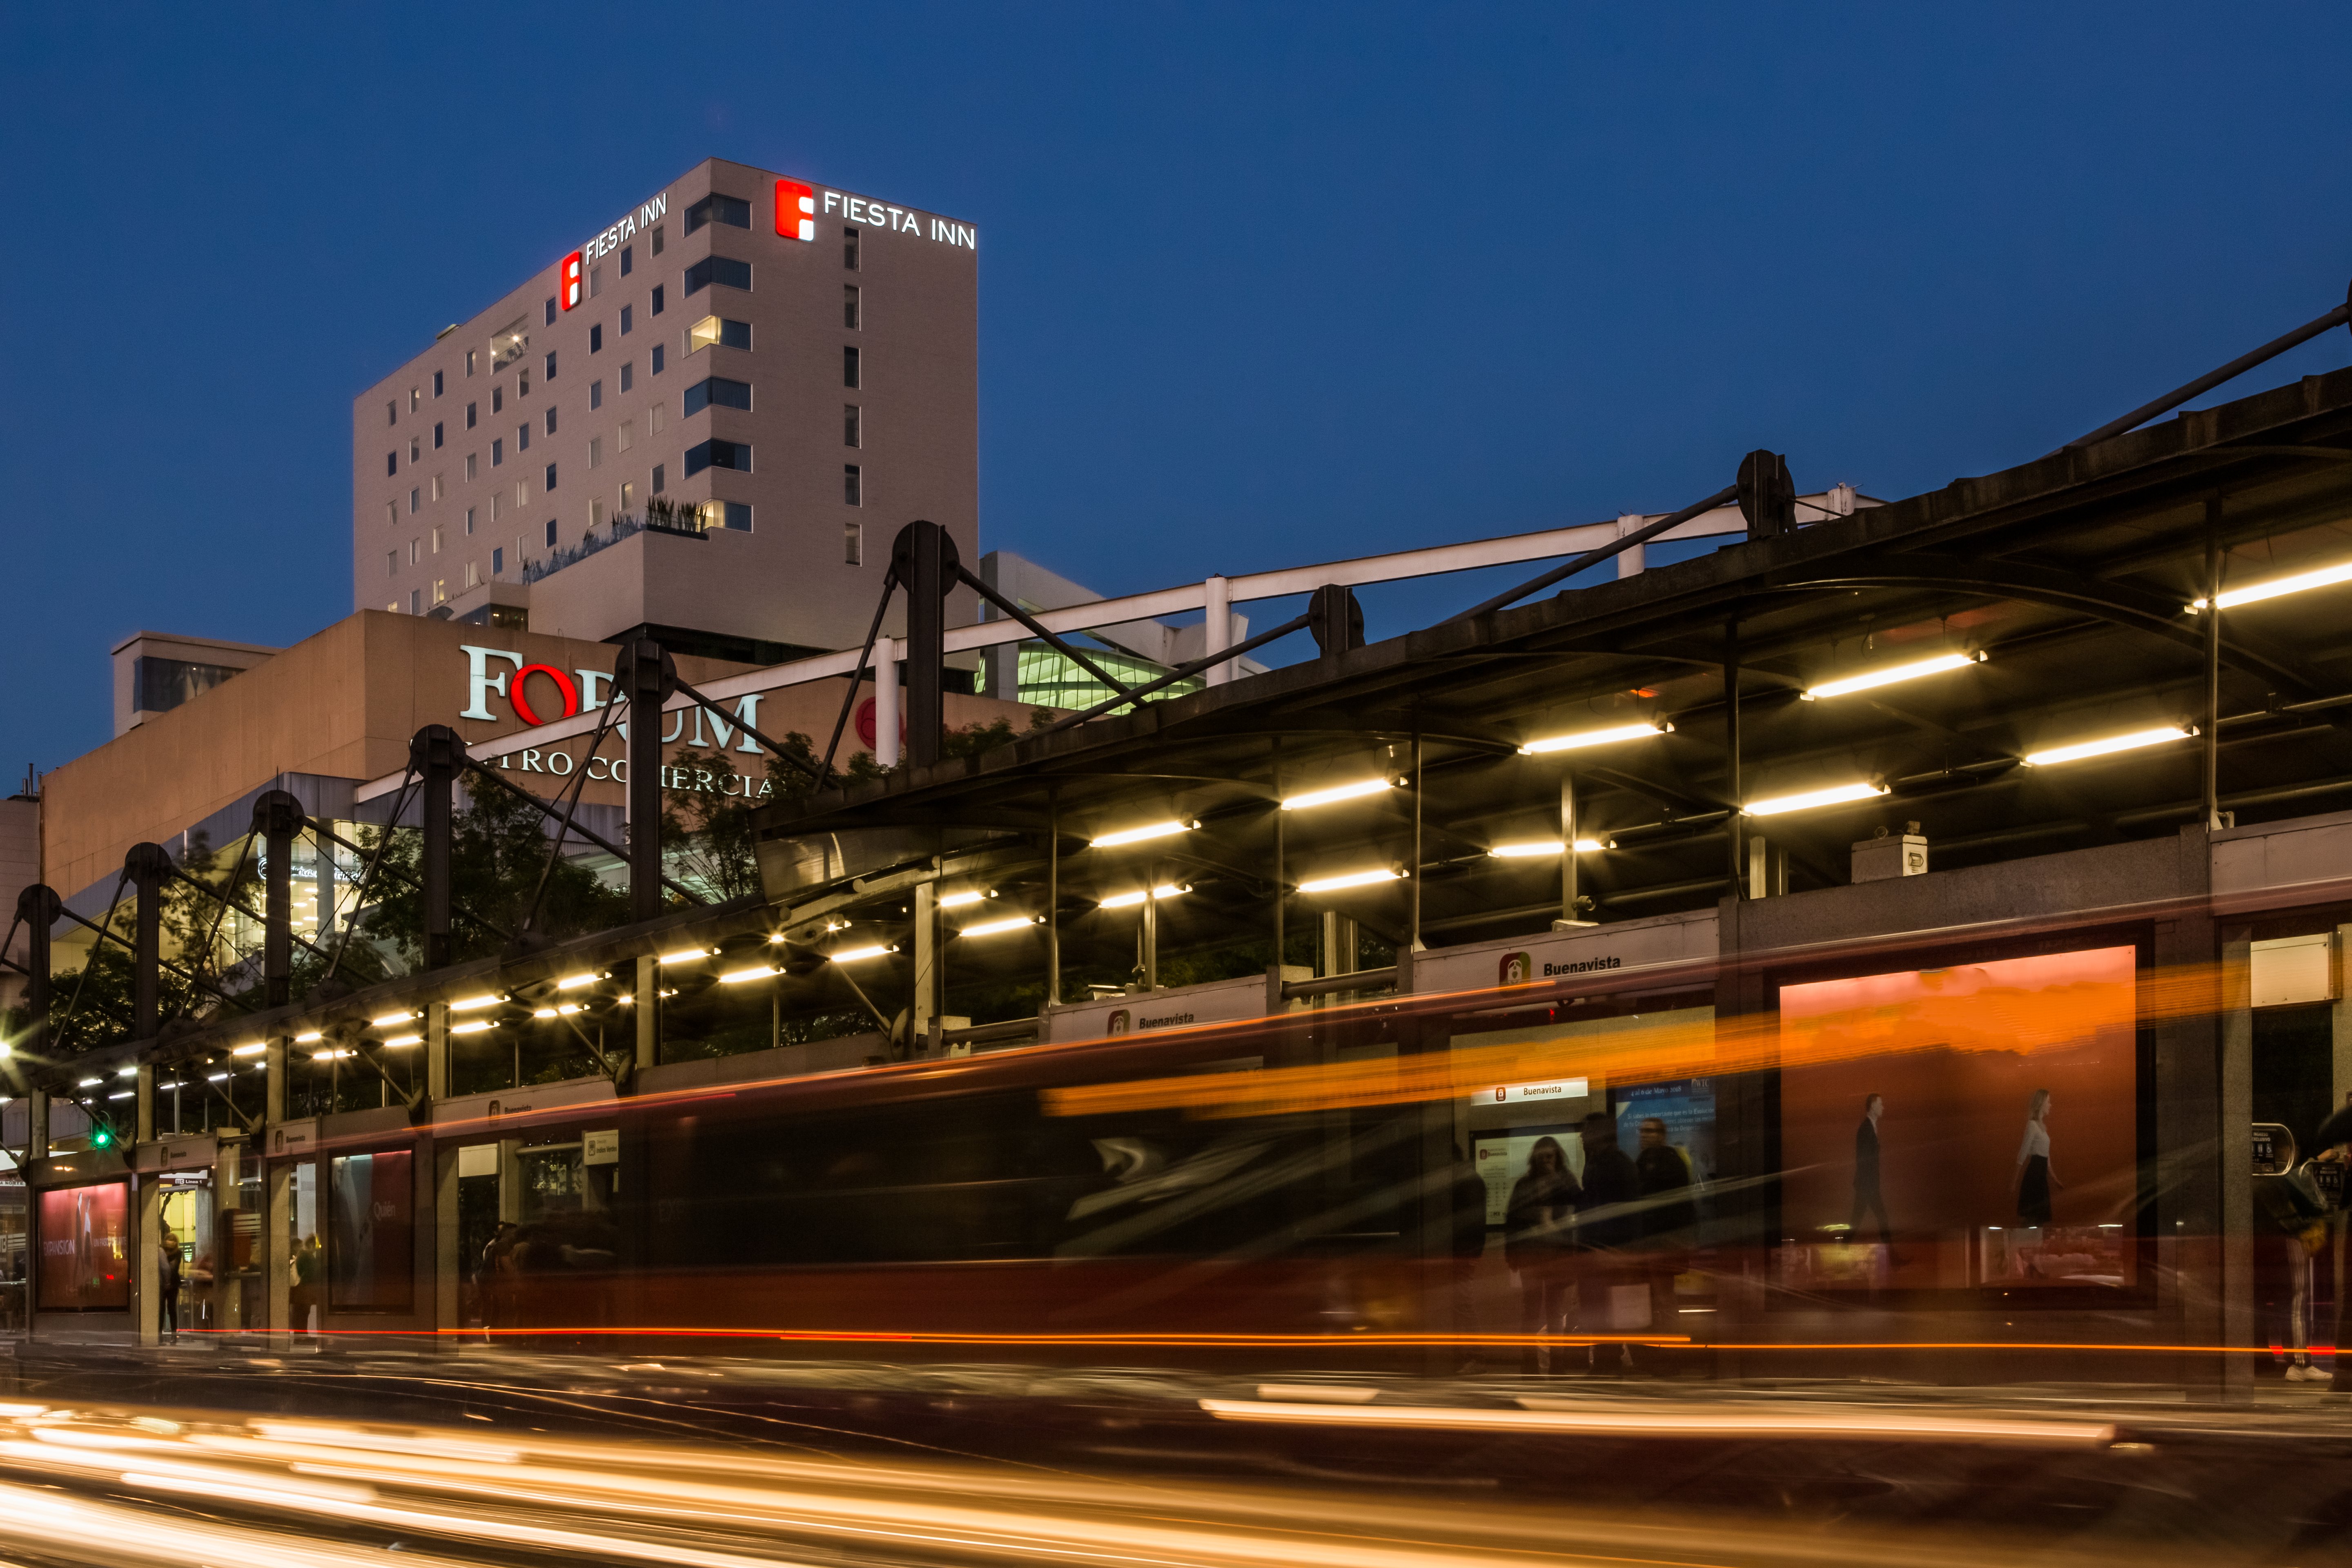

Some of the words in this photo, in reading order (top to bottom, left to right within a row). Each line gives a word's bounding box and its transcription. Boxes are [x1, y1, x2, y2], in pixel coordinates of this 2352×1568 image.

[824, 191, 920, 236] FIESTA
[931, 218, 974, 250] INN
[586, 216, 636, 265] FIESTA
[641, 193, 666, 229] INN
[1544, 956, 1621, 976] Buenavista
[1139, 1013, 1194, 1029] Buenavista
[1523, 1085, 1562, 1096] Buenavista
[1653, 1087, 1668, 1096] Mayo
[505, 1105, 532, 1115] Buenavista
[286, 1135, 306, 1143] Buenavista
[373, 1200, 396, 1221] Quién
